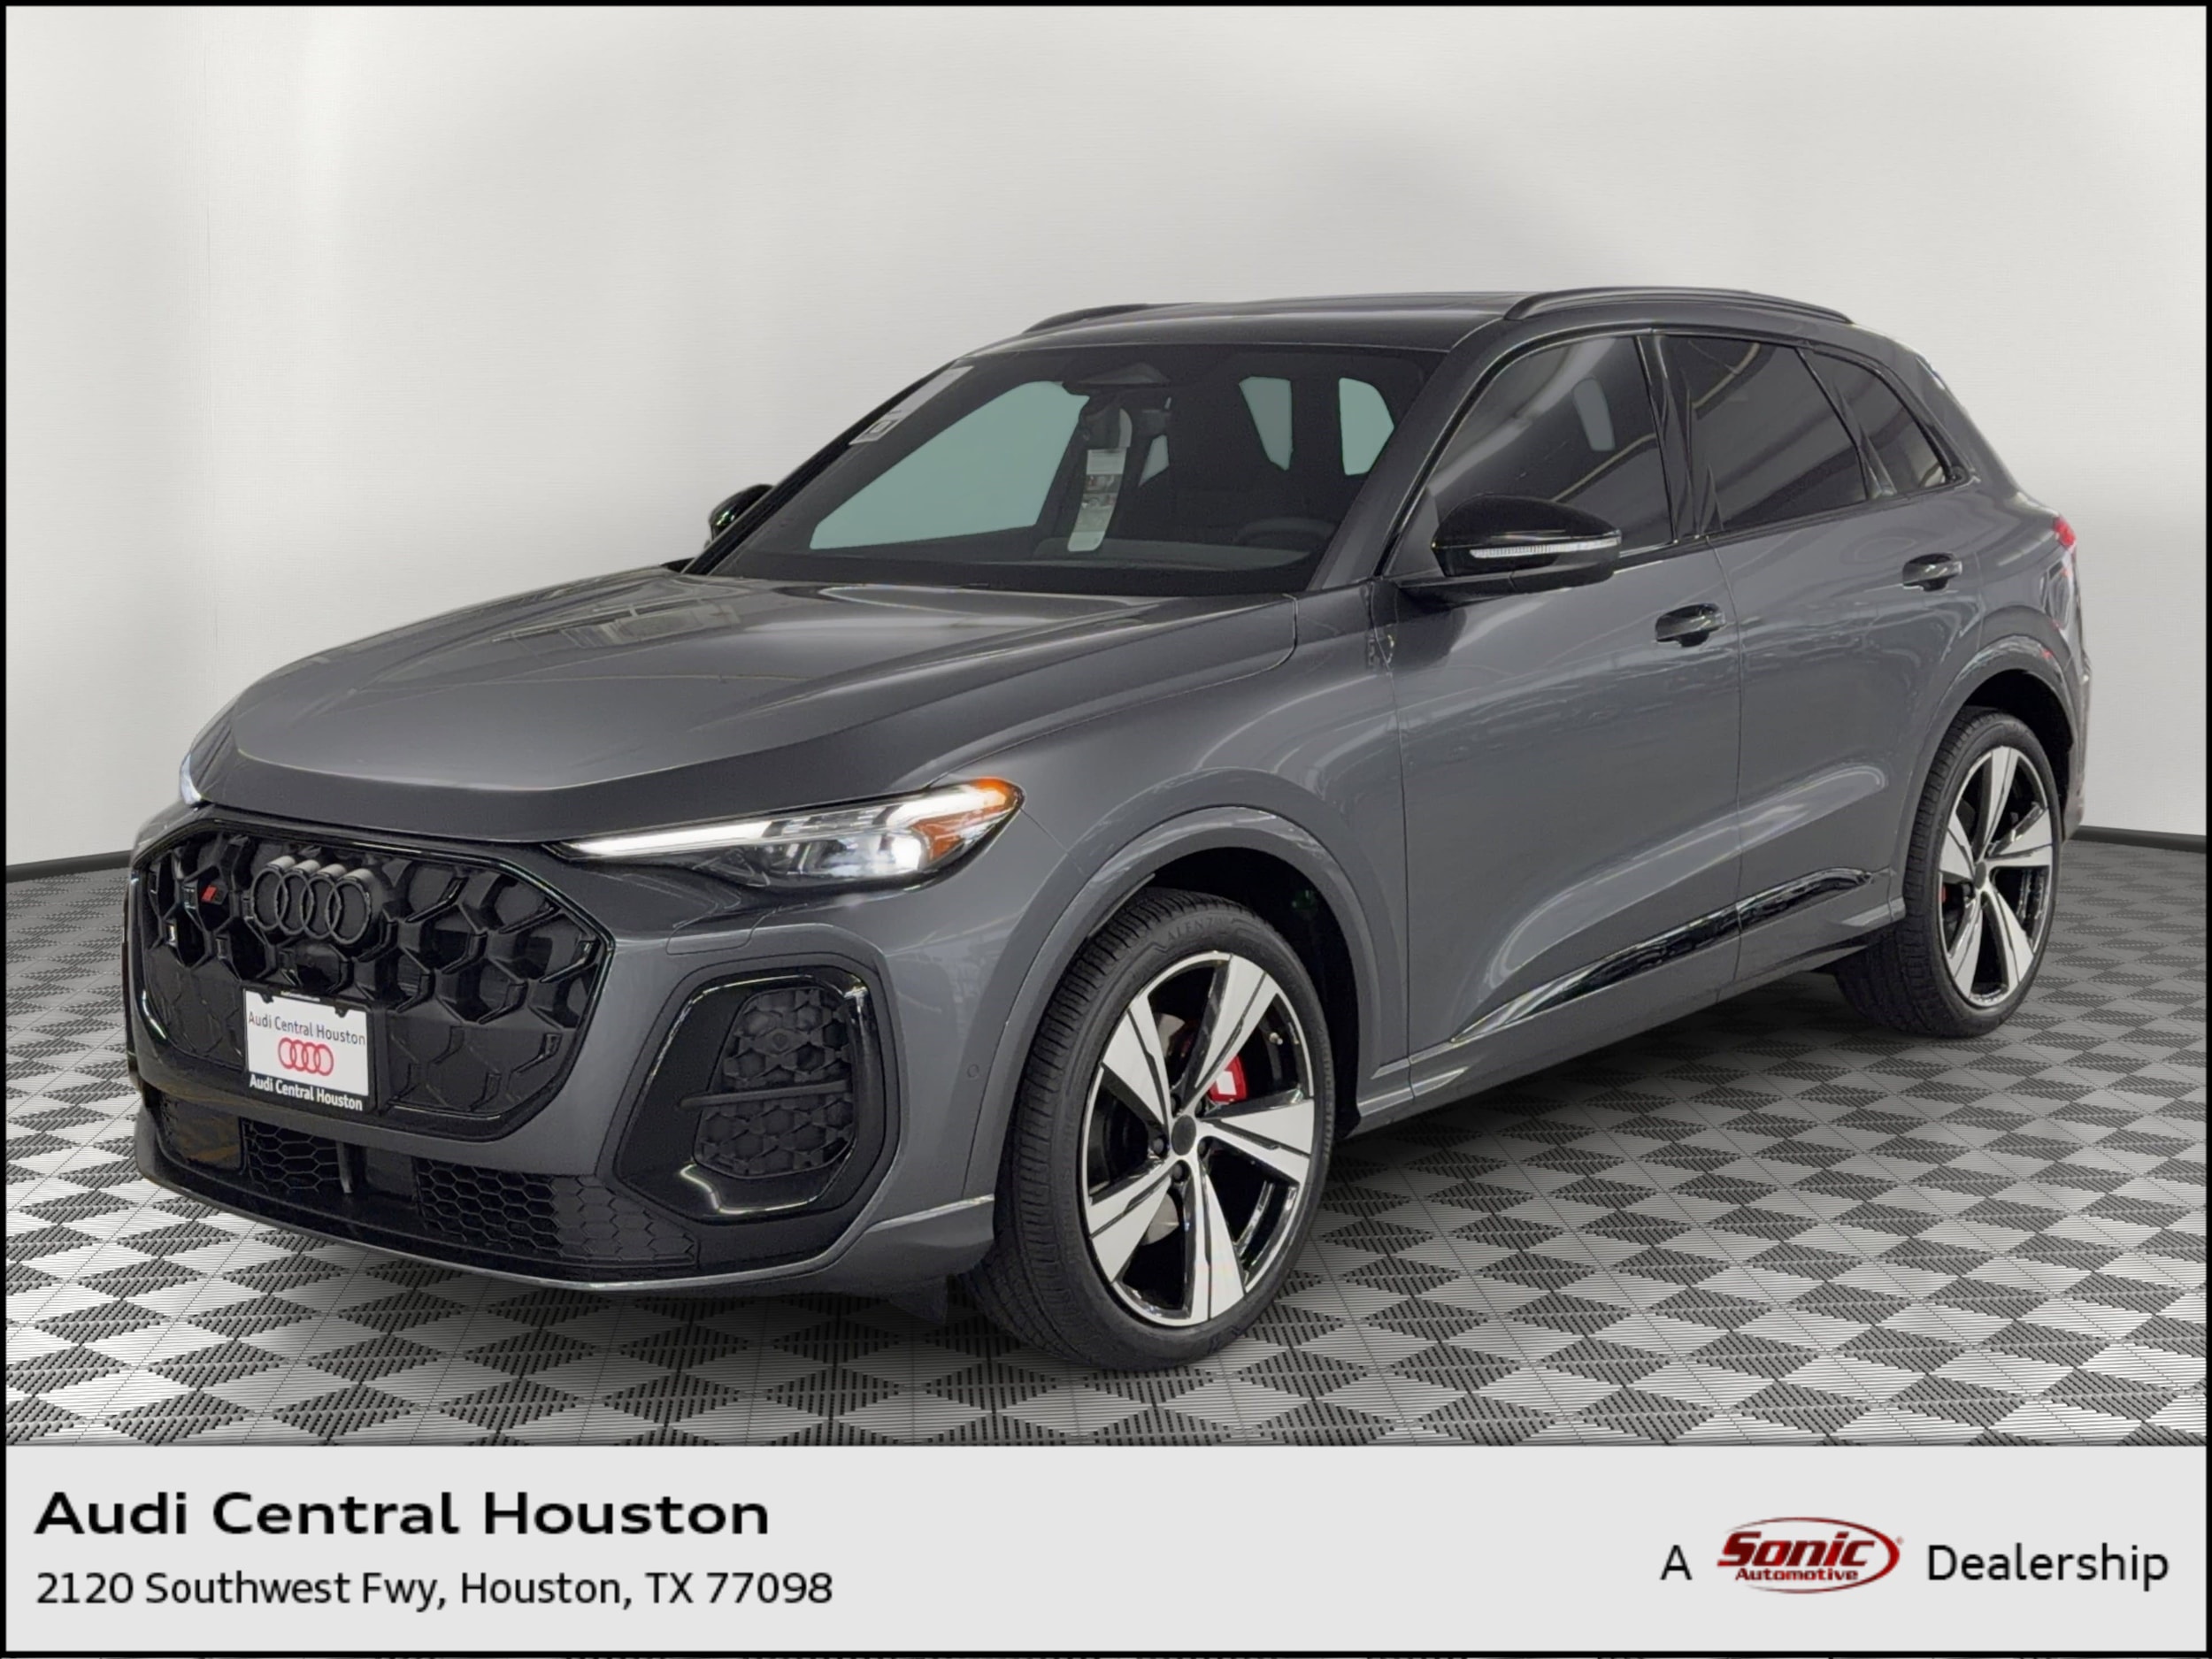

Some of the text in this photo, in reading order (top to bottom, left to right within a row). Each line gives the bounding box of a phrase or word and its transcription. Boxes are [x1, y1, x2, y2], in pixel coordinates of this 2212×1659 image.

[249, 1011, 365, 1046] Audi Central Houston
[250, 1074, 363, 1111] Audi Central Houston
